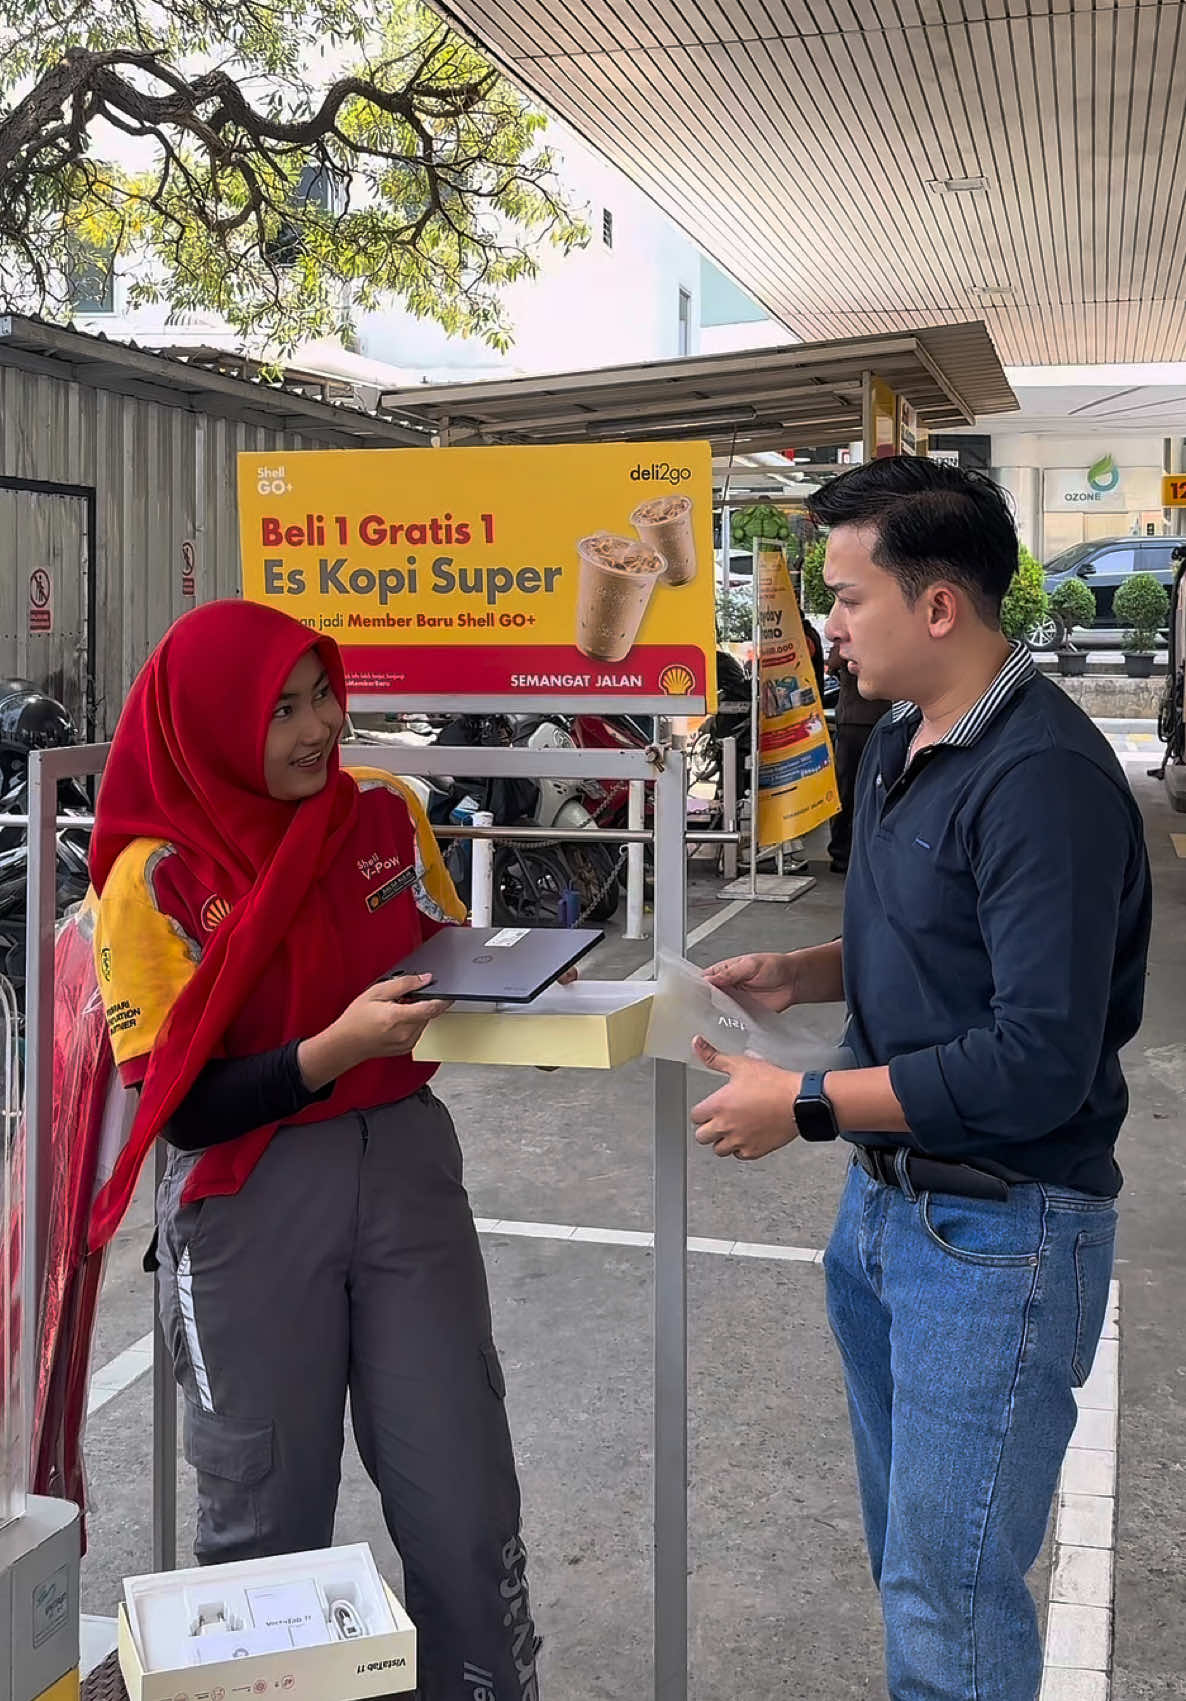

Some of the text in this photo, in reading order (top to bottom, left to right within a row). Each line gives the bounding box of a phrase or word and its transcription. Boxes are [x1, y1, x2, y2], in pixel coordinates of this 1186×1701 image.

[257, 466, 286, 478] Shell
[630, 463, 692, 485] deli2go
[257, 480, 293, 496] GO+
[1064, 492, 1101, 501] OZONE
[261, 513, 495, 547] Beli 1 Gratis 1
[263, 557, 562, 605] Es Kopi Super
[300, 613, 536, 631] an jadi Member Baru Shell GO+
[510, 674, 643, 688] SEMANGAT JALAN
[357, 852, 380, 869] Shell
[464, 1660, 495, 1701] ell
